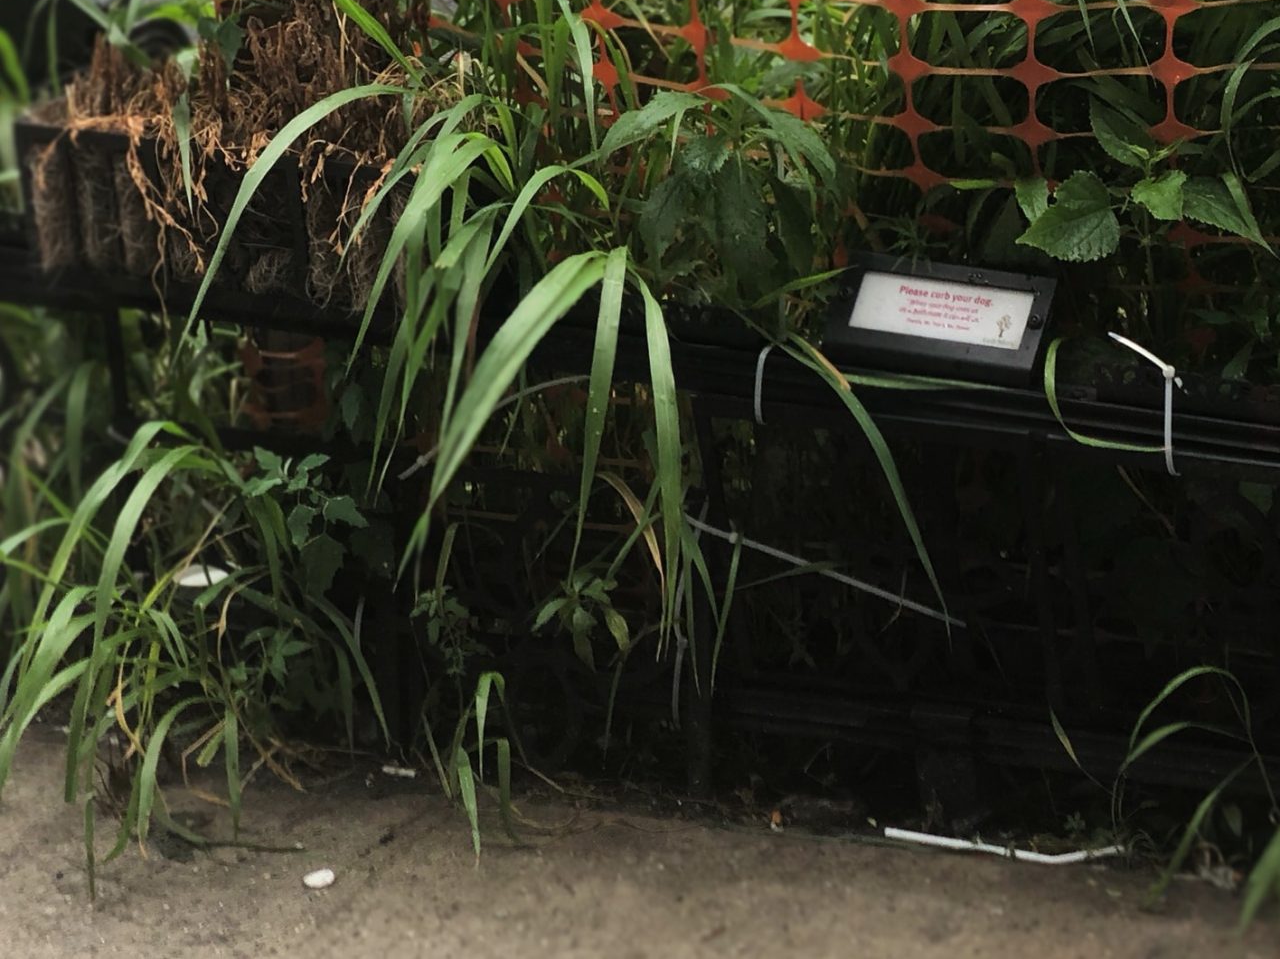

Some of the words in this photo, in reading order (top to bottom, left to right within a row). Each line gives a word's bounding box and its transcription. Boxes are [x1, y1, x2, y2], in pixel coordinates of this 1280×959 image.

[899, 285, 929, 297] Please
[930, 290, 951, 301] curb
[952, 294, 973, 303] your
[974, 295, 994, 308] dog.
